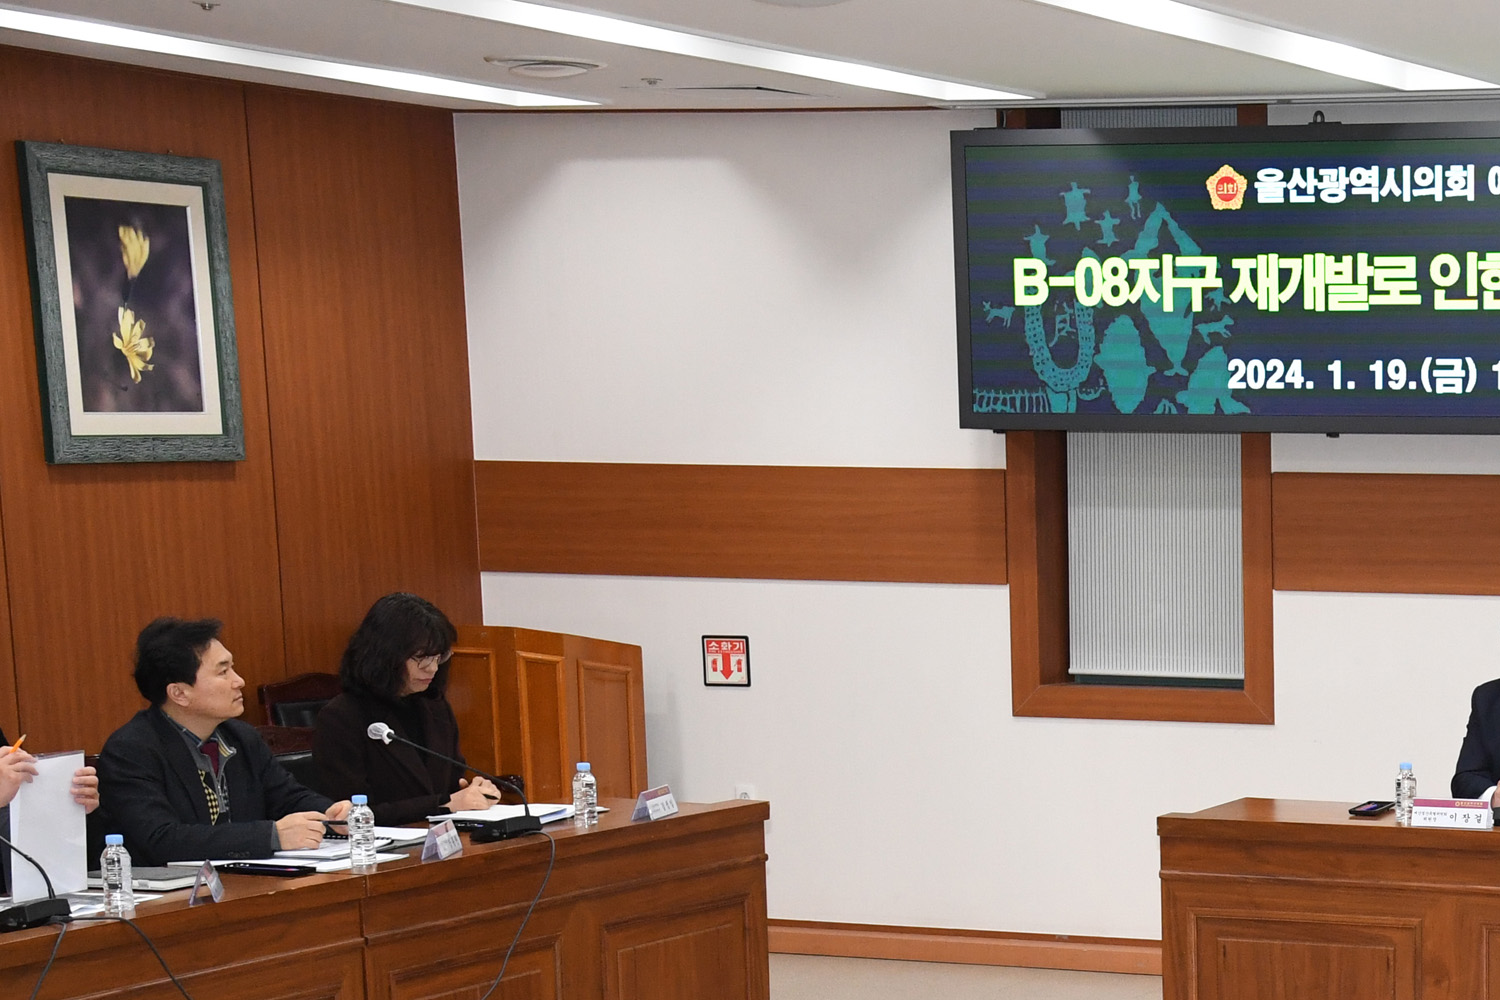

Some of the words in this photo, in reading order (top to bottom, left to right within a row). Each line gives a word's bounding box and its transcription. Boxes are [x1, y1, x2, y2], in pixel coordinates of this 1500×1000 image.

[1253, 164, 1475, 204] 울산광역시의회
[1013, 253, 1223, 313] B-08지구
[1229, 252, 1422, 312] 재개발로
[1227, 358, 1314, 390] 2024.
[1327, 359, 1356, 390] 1.
[1369, 356, 1477, 394] 19.(금)
[708, 641, 743, 651] 소화기
